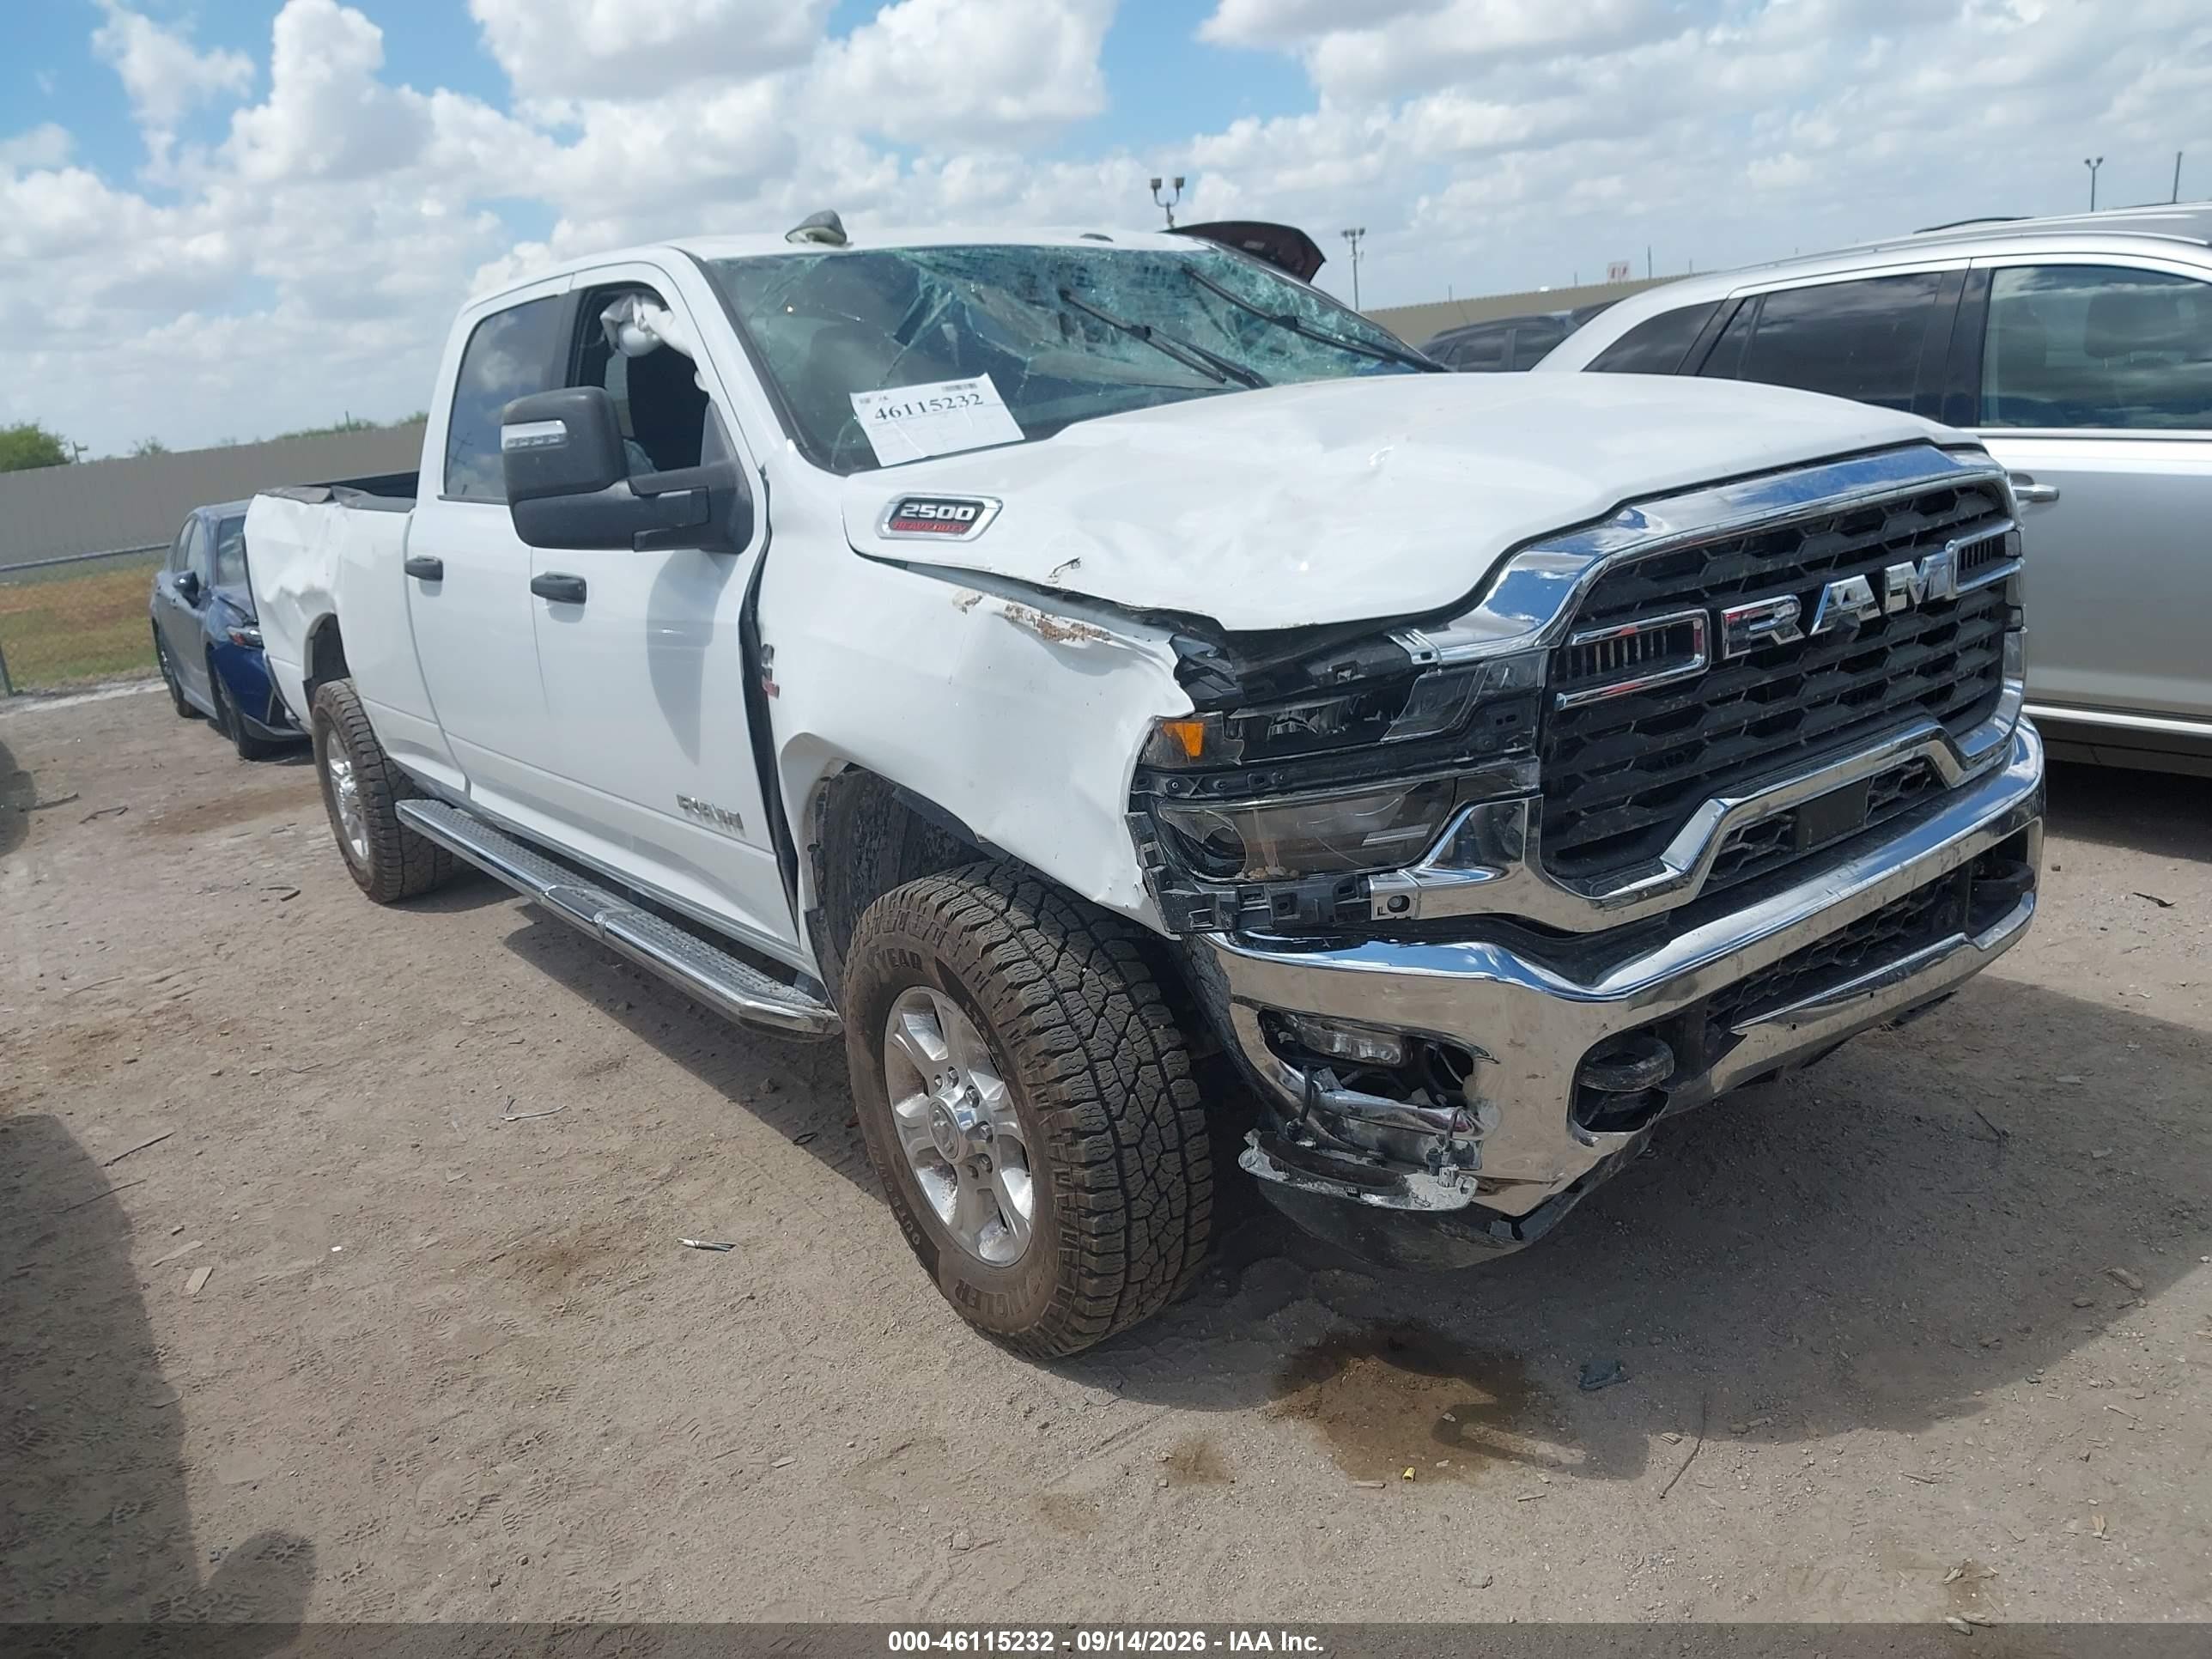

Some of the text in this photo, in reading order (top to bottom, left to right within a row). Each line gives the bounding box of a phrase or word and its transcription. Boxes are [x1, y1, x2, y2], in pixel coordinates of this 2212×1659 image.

[874, 393, 984, 421] 46115232
[900, 502, 976, 521] 2500
[1721, 541, 1958, 659] RAM
